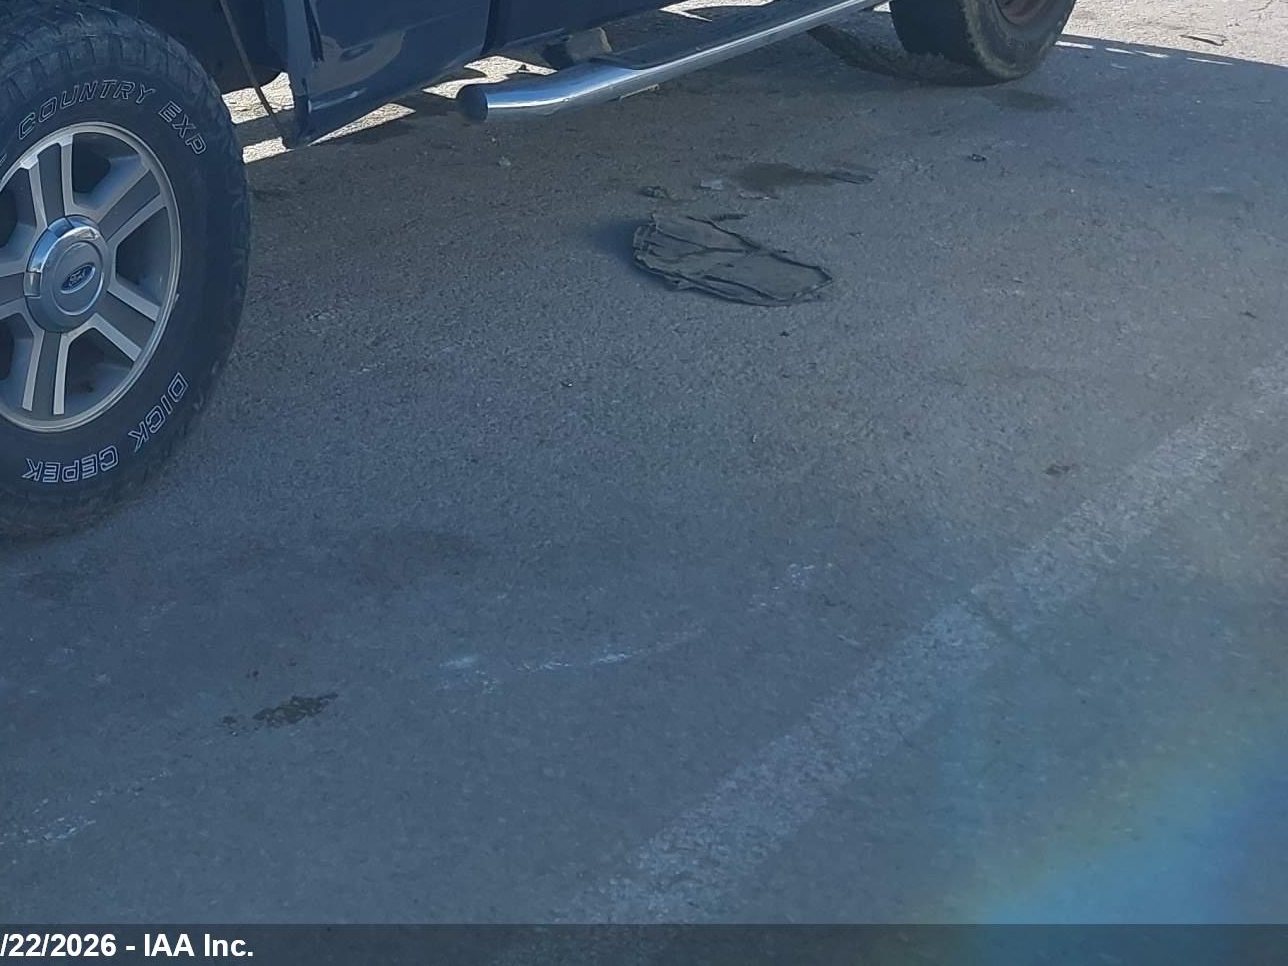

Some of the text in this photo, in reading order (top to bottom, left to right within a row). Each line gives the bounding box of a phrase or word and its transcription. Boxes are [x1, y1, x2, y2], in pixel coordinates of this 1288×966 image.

[18, 79, 156, 140] COUNTRY
[158, 100, 207, 155] EXP
[22, 372, 189, 483] DICK CEPEK
